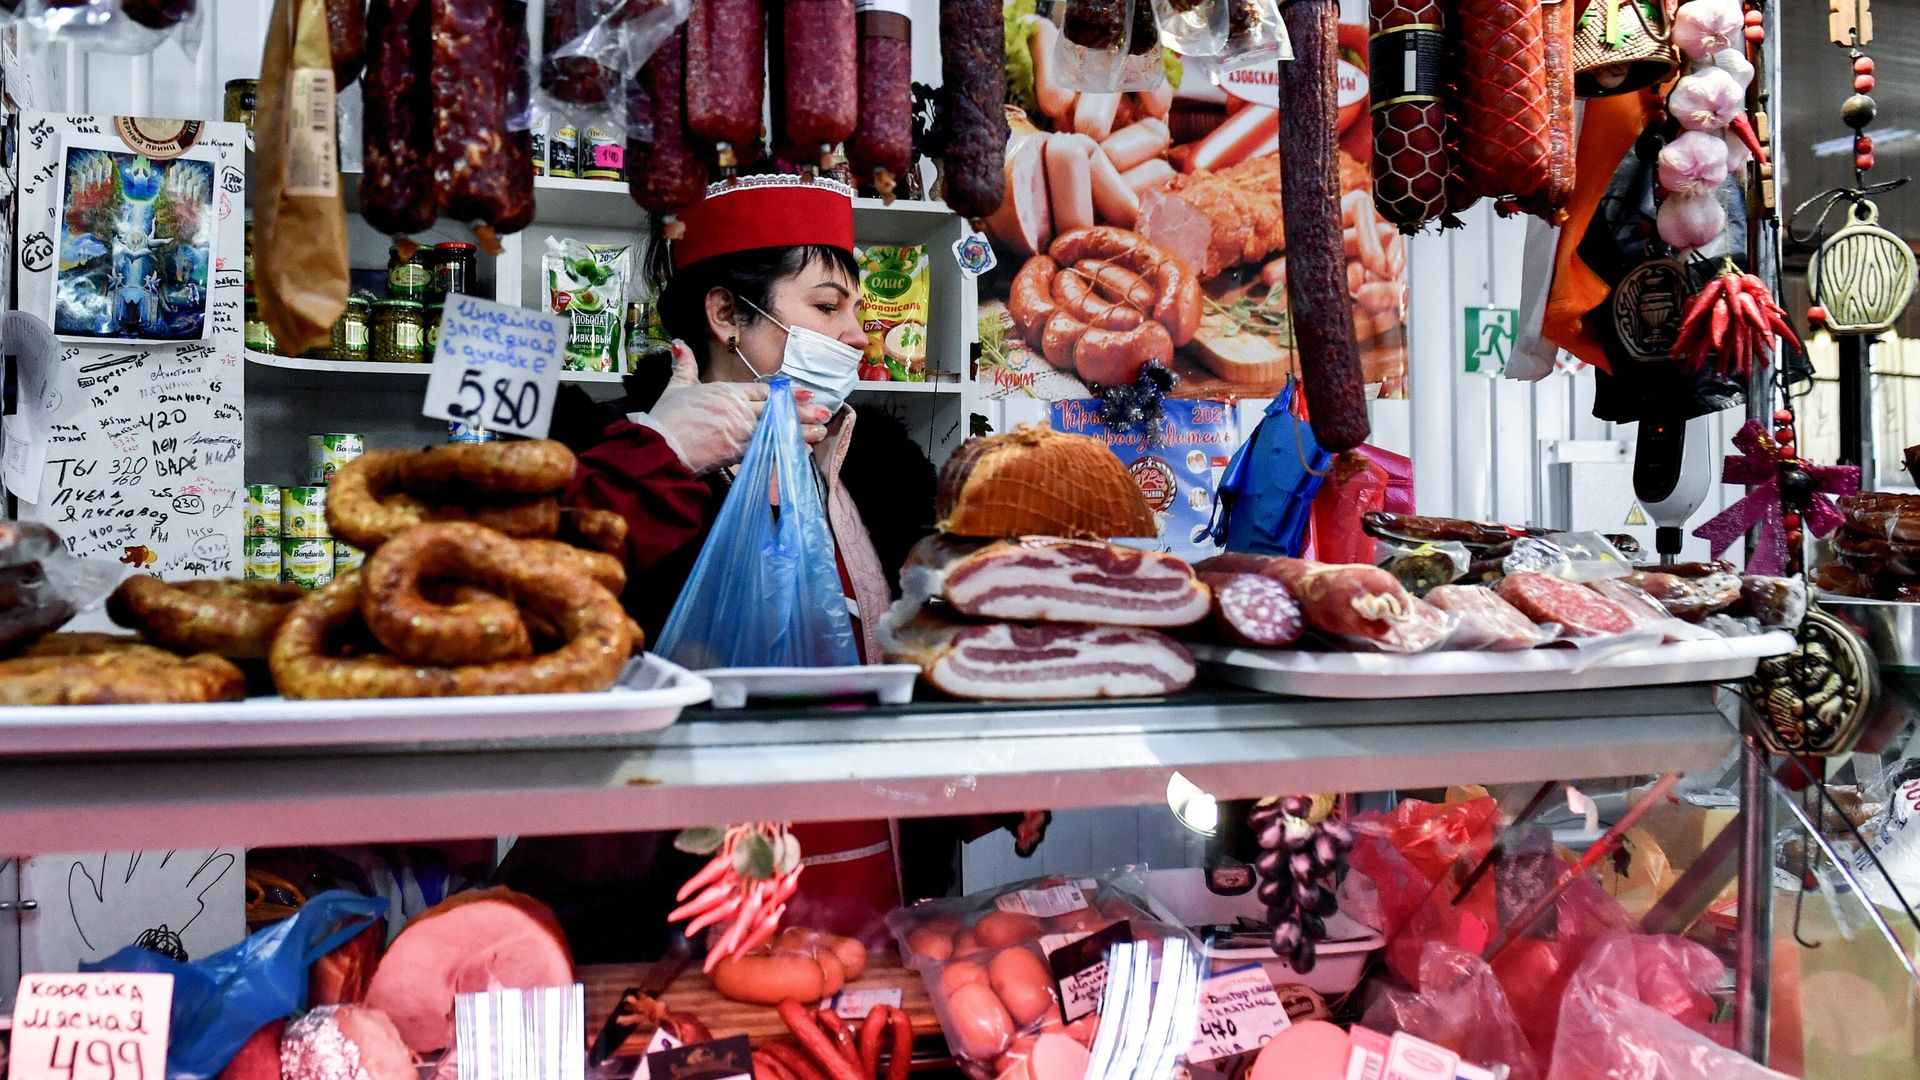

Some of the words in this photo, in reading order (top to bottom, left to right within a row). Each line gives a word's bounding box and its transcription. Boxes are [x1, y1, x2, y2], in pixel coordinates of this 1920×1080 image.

[145, 141, 177, 152] ПРИНЦ
[26, 244, 54, 266] 650
[864, 321, 882, 331] 67%
[567, 333, 612, 346] ЛИВКОВЫЙ
[994, 368, 1035, 395] Крым
[447, 369, 540, 429] 580
[138, 408, 187, 433] 420
[1093, 422, 1232, 454] произдитель
[108, 456, 148, 475] 320
[173, 498, 200, 509] 230
[88, 525, 113, 539] 400
[97, 538, 123, 552] 480
[293, 549, 326, 560] Bonduelle
[48, 1035, 145, 1080] 499
